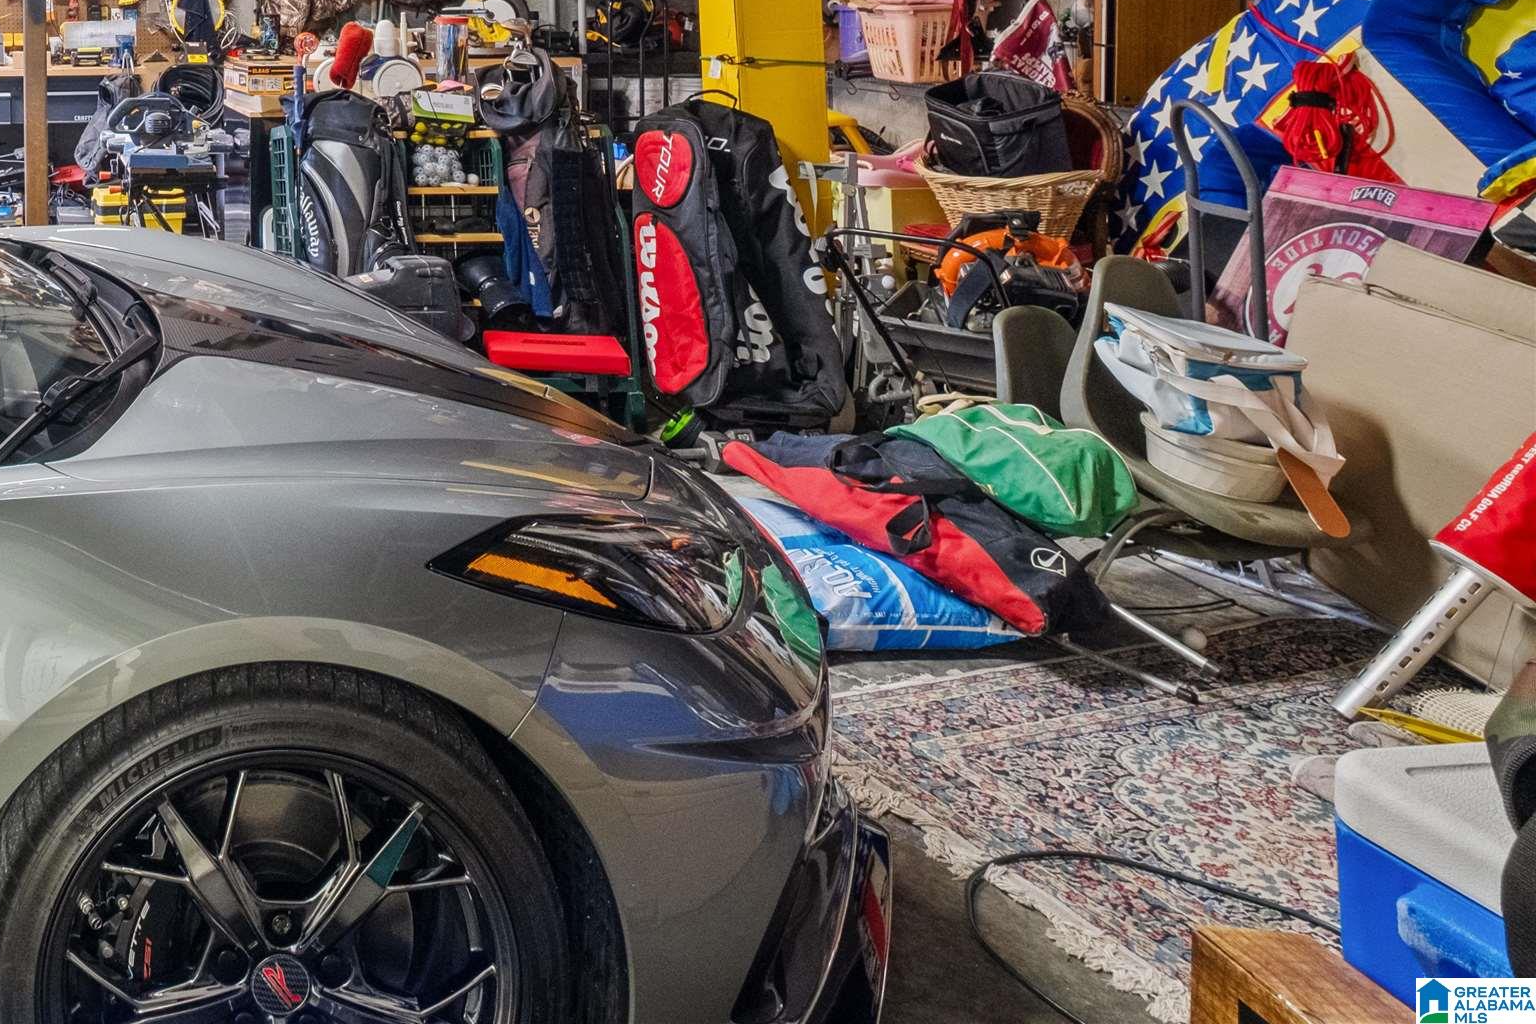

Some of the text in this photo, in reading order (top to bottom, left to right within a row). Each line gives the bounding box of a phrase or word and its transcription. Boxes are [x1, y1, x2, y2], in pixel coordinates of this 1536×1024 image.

[650, 133, 674, 202] TOUR
[1350, 185, 1398, 208] BAMA
[300, 188, 320, 257] allaway
[1270, 230, 1325, 272] TIDE
[1487, 462, 1524, 499] GEORGIA
[1469, 497, 1494, 522] GOLF
[99, 730, 216, 809] MICHELIN
